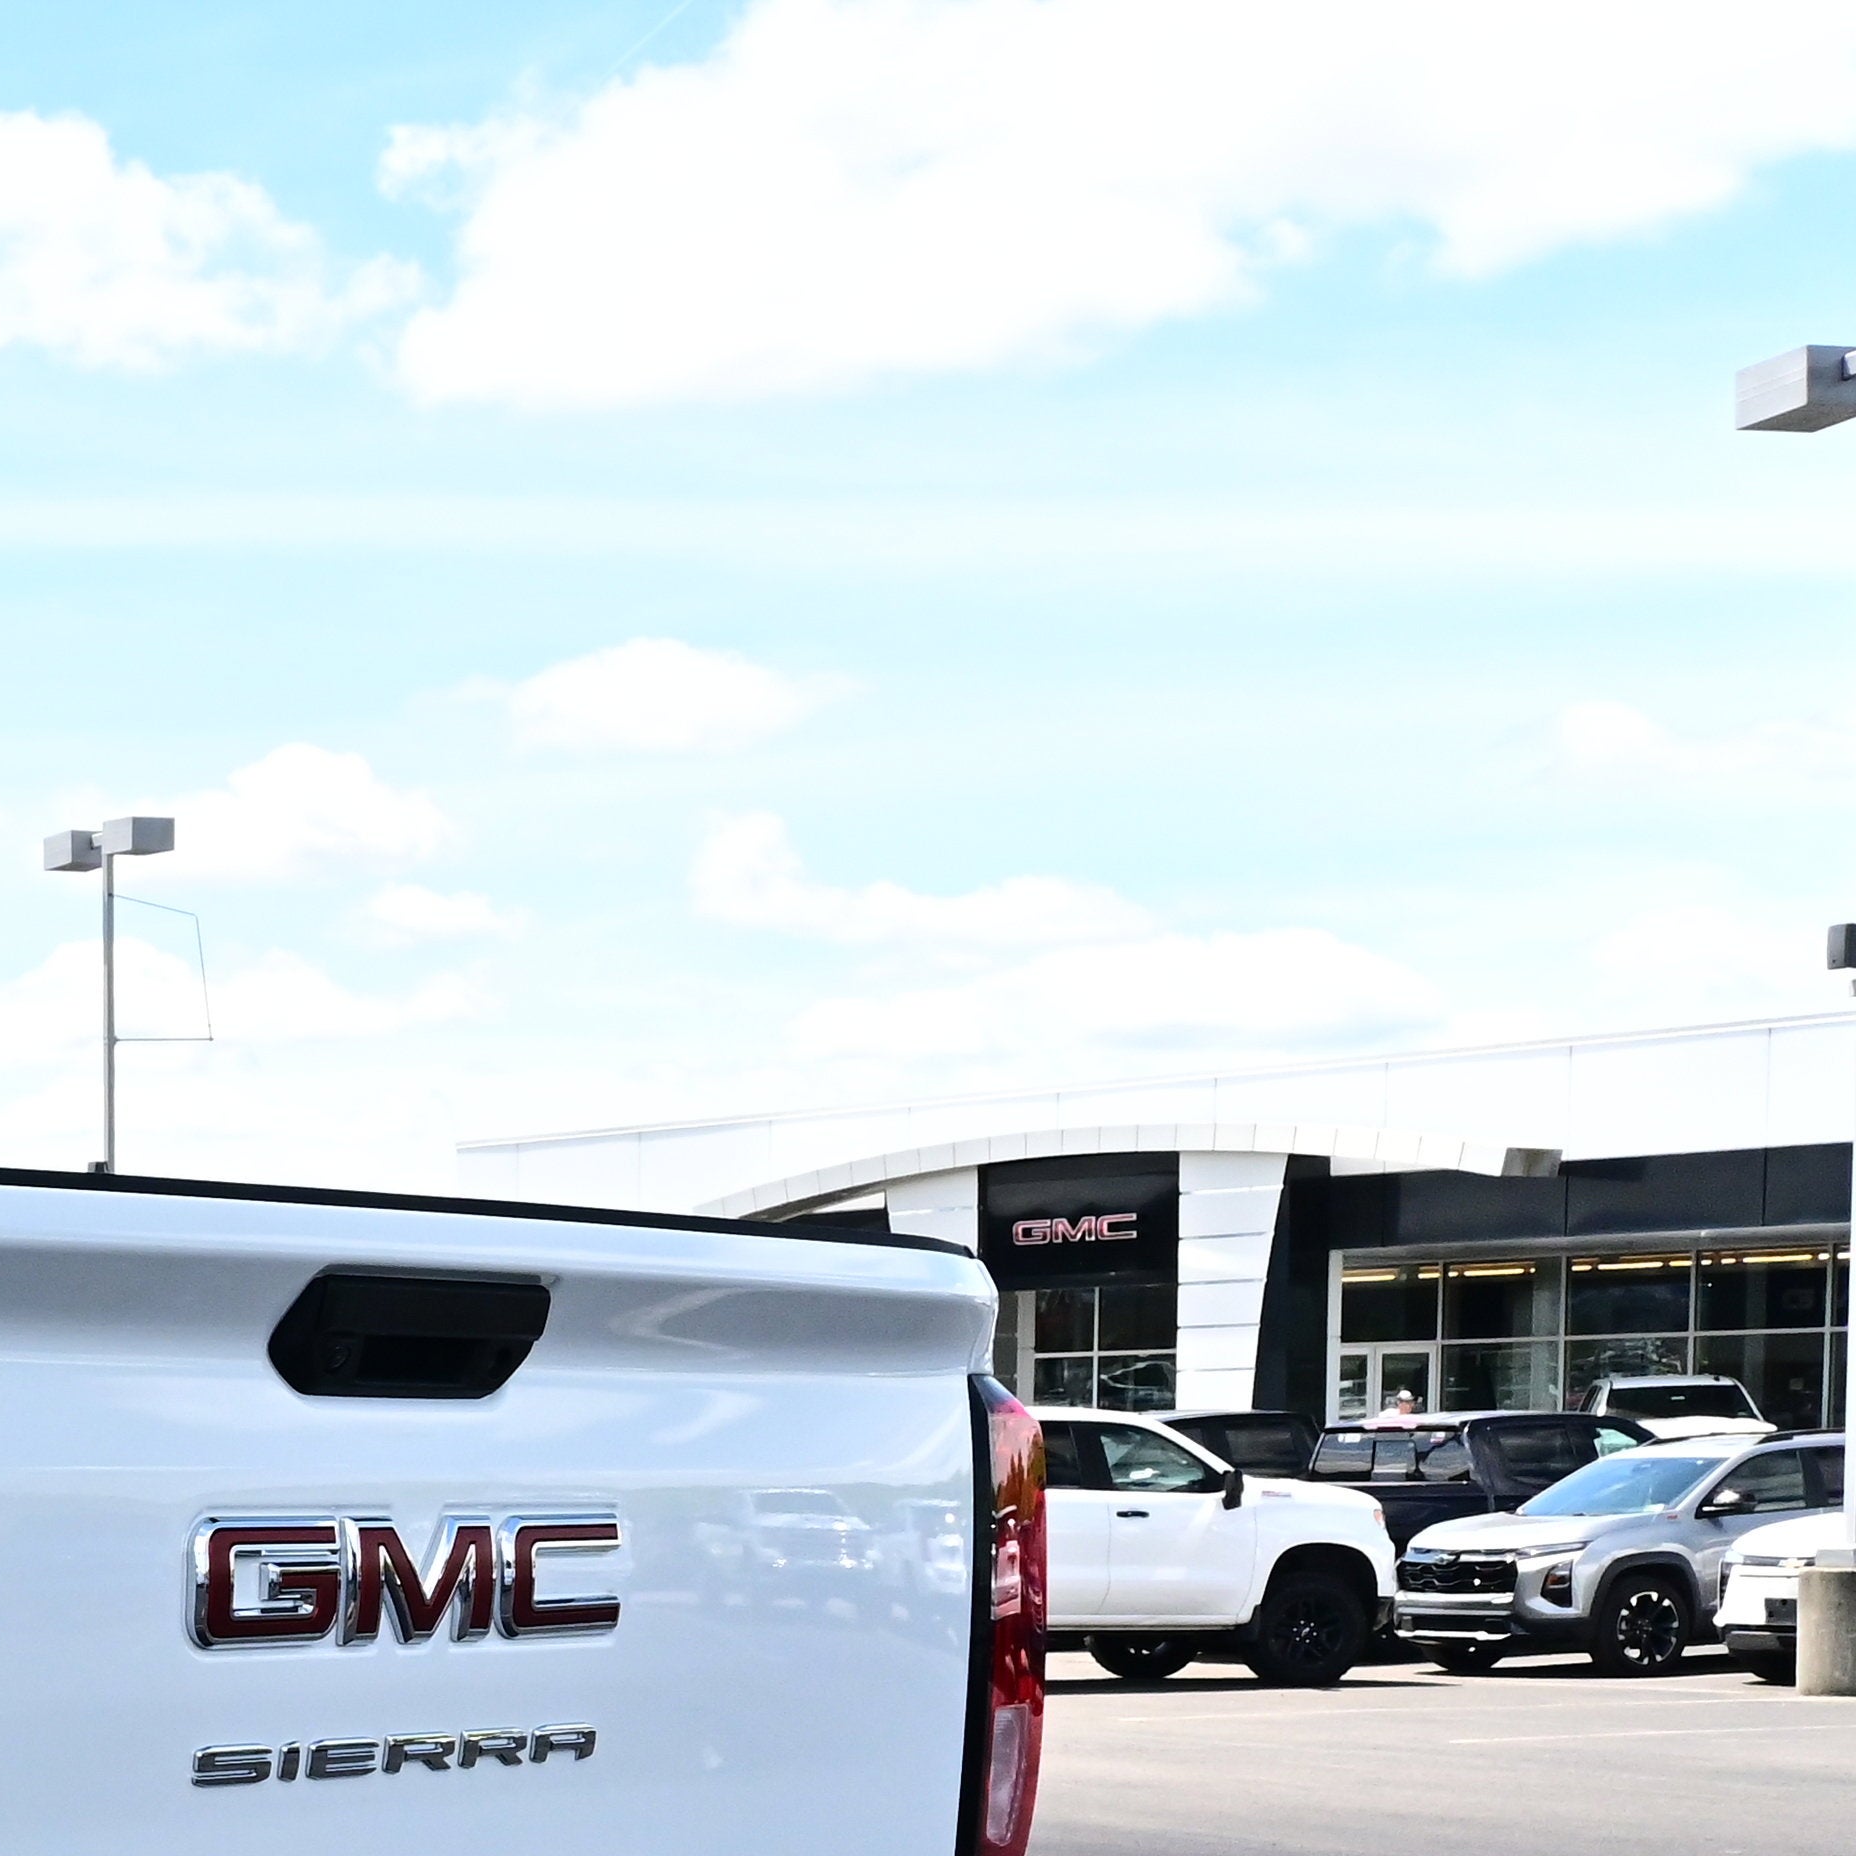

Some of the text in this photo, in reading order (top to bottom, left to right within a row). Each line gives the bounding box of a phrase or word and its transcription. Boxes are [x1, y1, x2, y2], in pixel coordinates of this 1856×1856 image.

[1012, 1212, 1138, 1246] GMC
[191, 1511, 623, 1650] GMC
[191, 1721, 598, 1788] SIERRA
